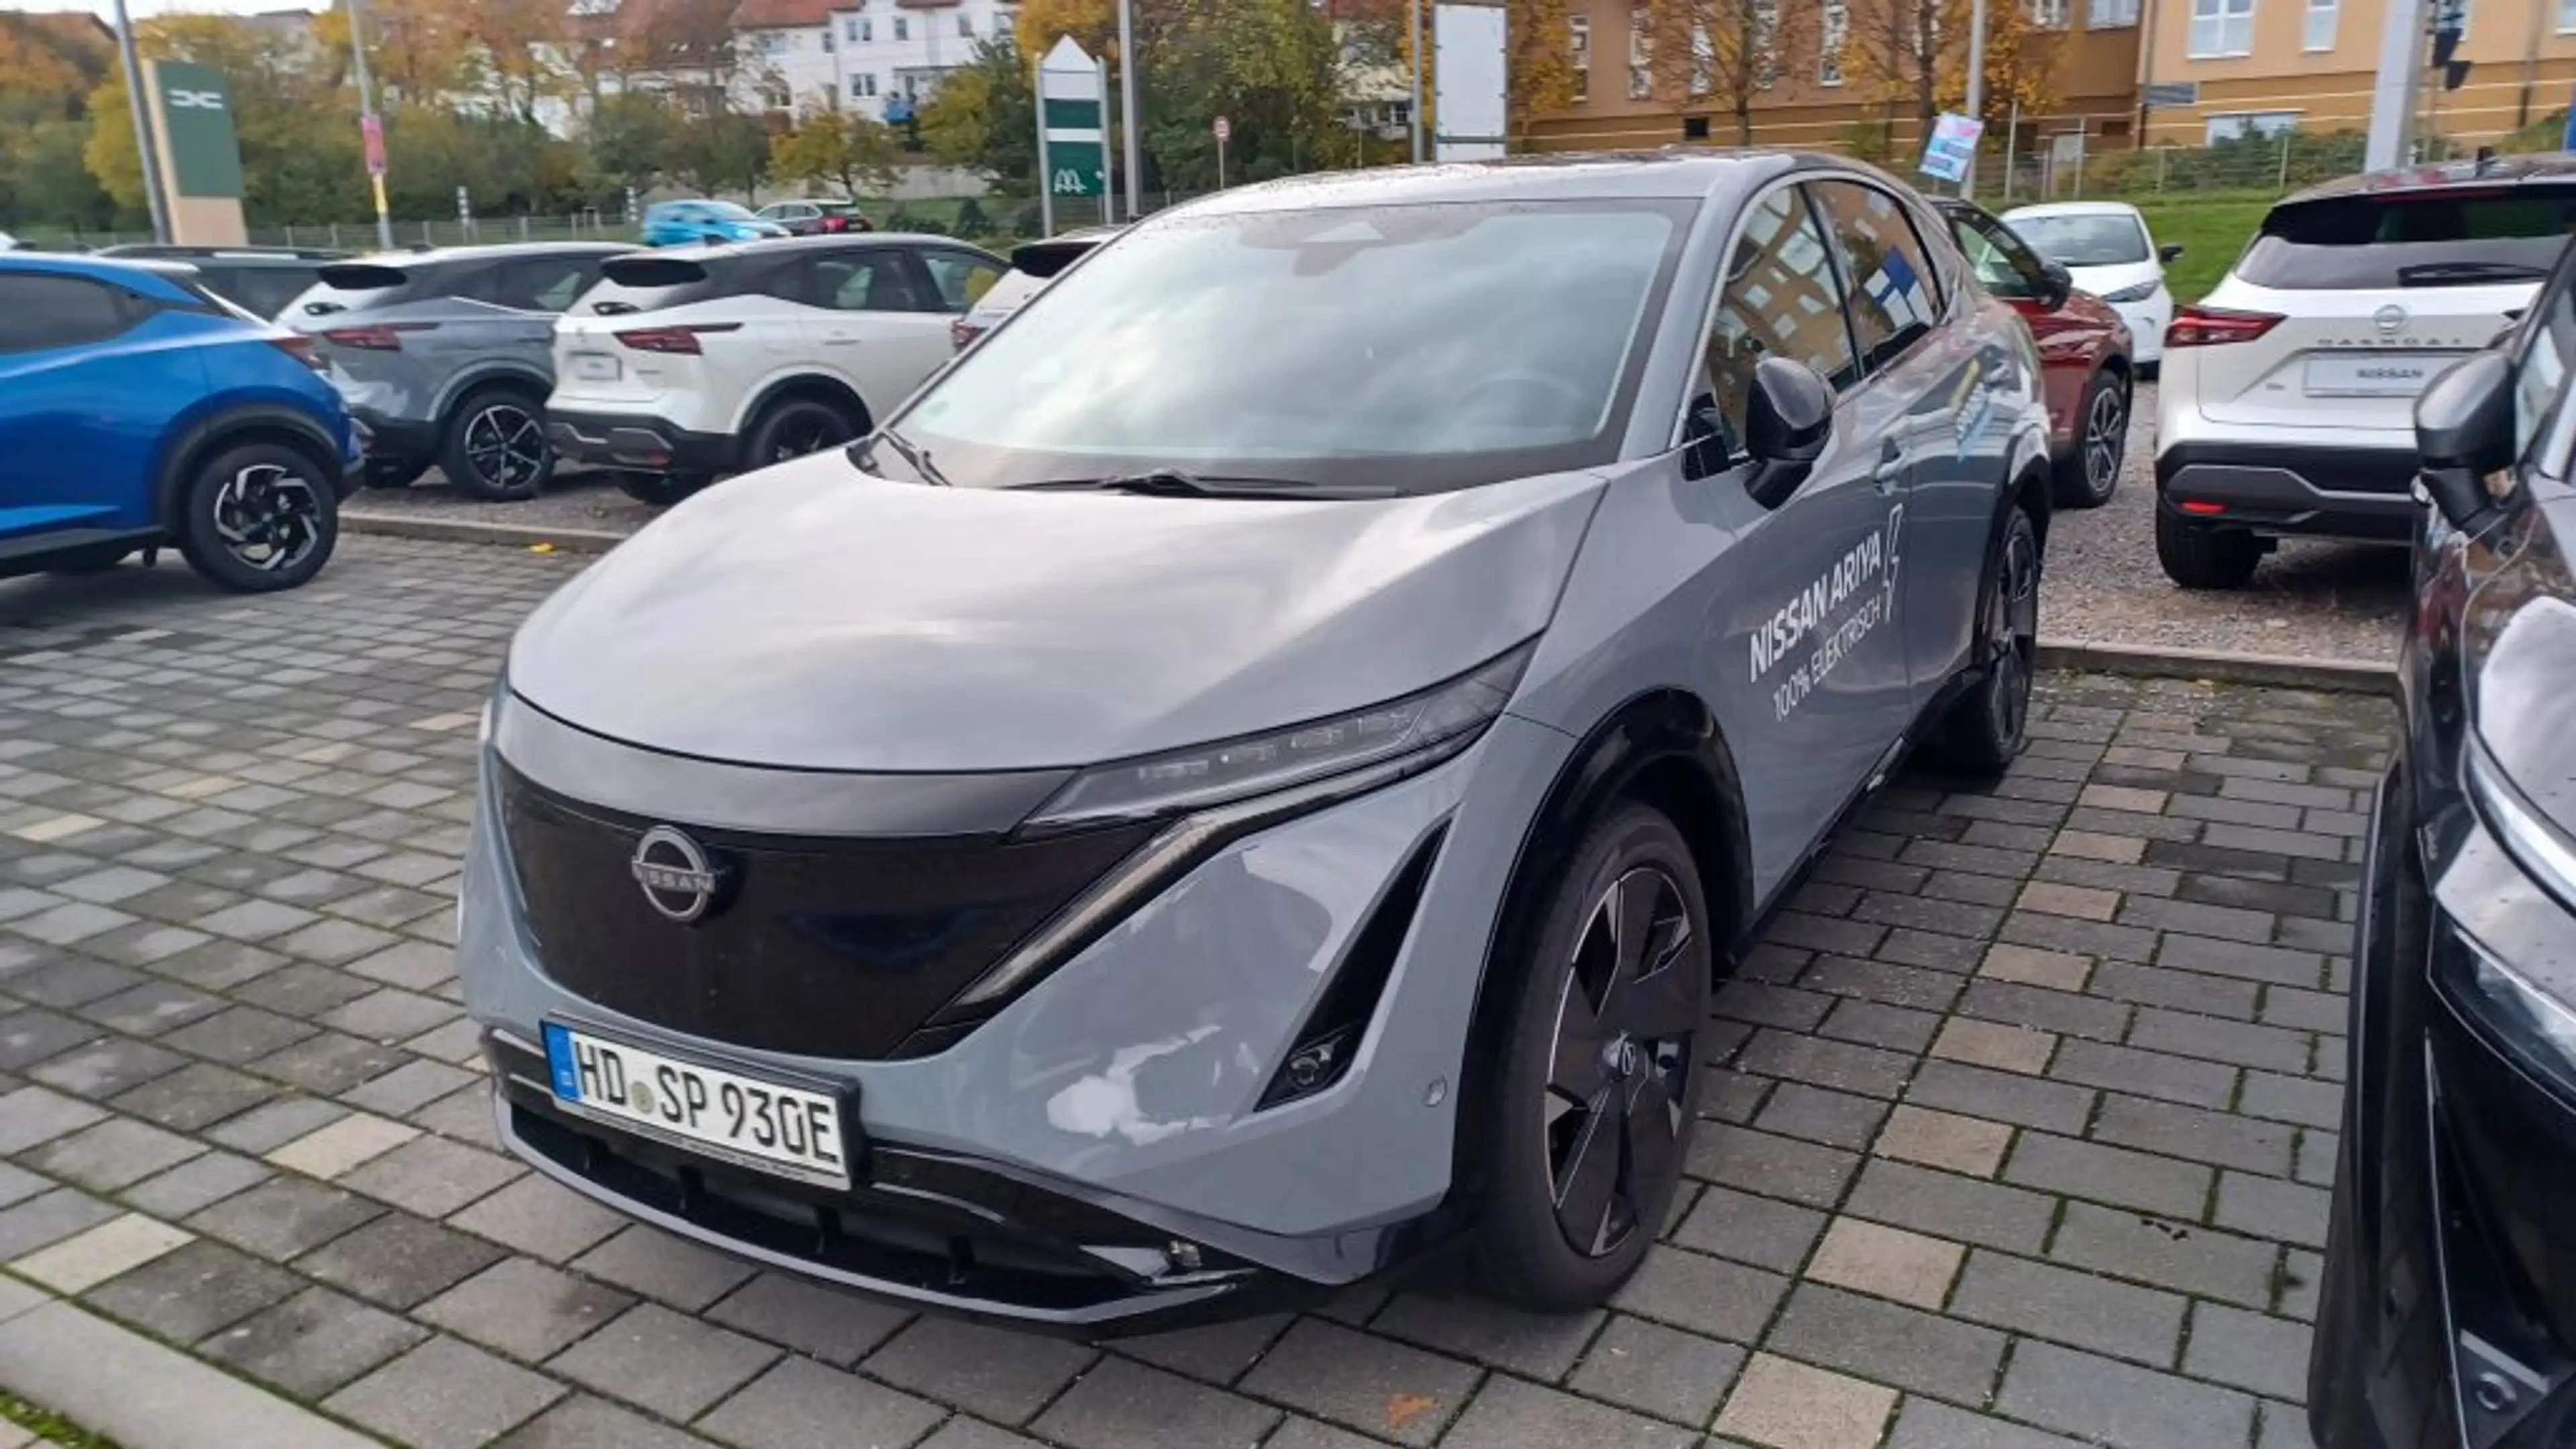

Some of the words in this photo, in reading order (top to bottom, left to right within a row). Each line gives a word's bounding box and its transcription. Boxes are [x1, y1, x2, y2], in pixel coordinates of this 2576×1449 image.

[1750, 573, 1828, 684] NISSAN
[1829, 530, 1881, 611] ARIYA
[1773, 663, 1810, 722] 100%
[1811, 594, 1881, 686] ELEKTRISCH
[575, 1040, 627, 1106] HD
[657, 1064, 707, 1128] SP
[721, 1082, 839, 1164] 930E
